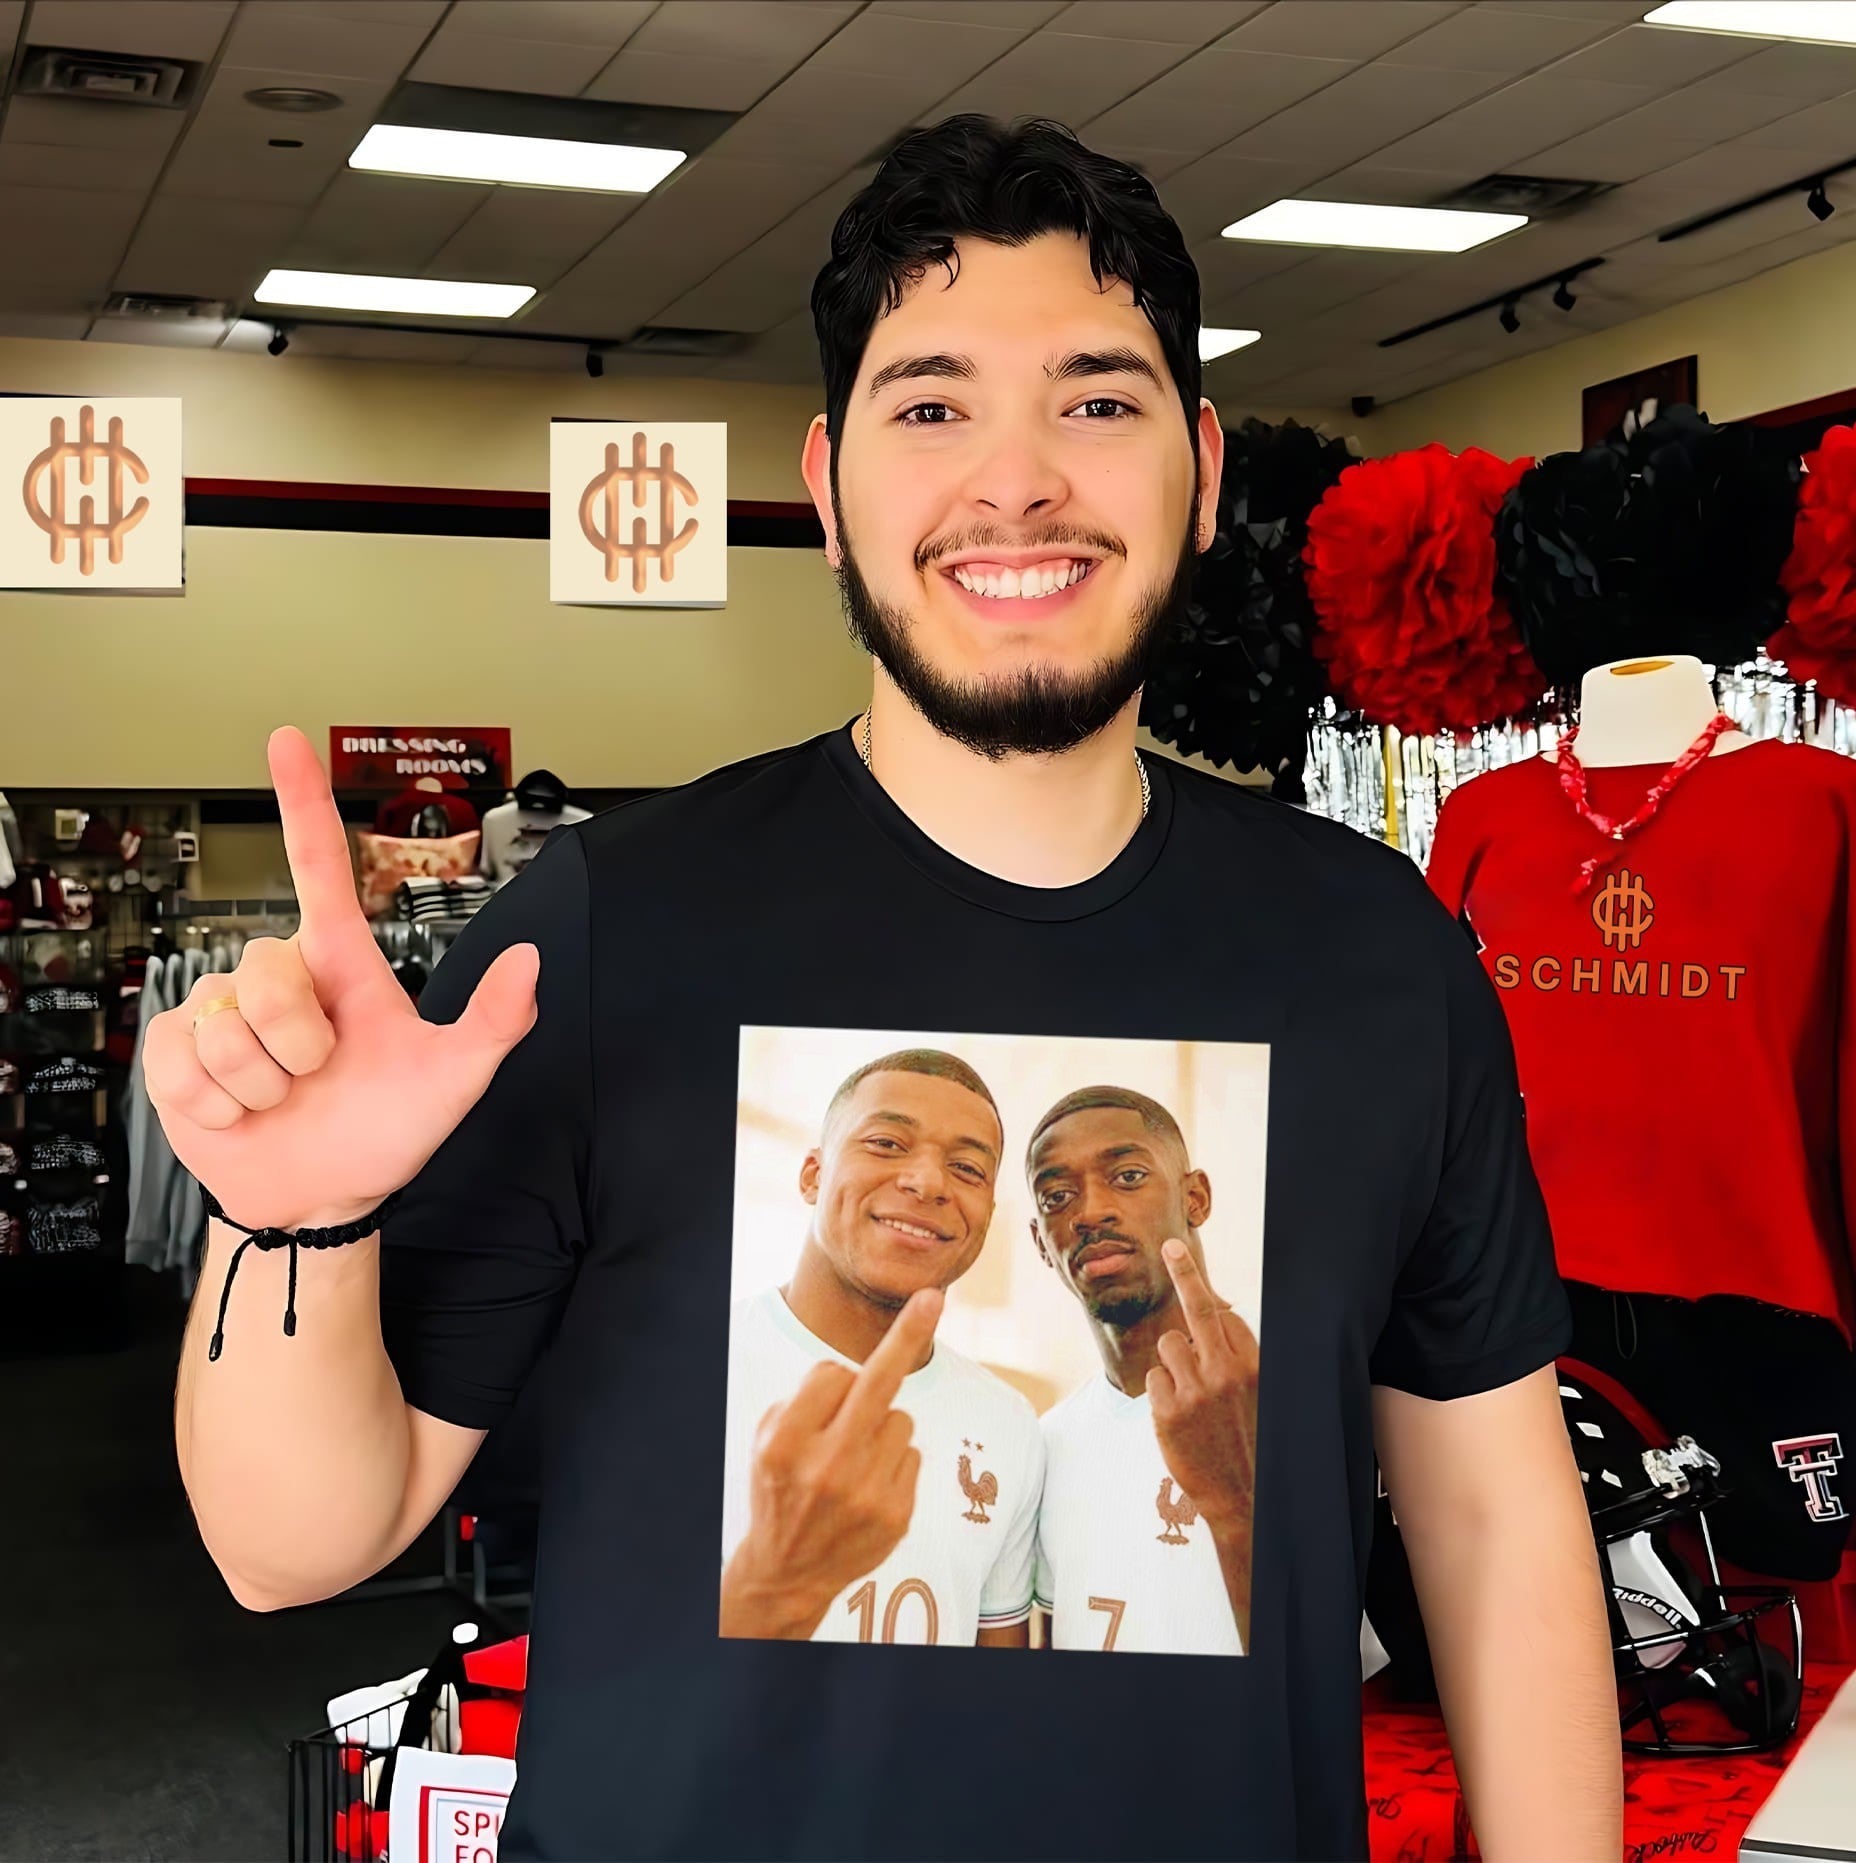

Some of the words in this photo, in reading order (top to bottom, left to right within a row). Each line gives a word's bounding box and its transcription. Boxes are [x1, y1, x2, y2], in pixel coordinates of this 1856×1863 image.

[342, 737, 467, 753] DRESSING
[396, 758, 487, 775] ROOMS
[1494, 953, 1747, 1000] SCHMIDT
[847, 1577, 939, 1645] 10
[1088, 1595, 1127, 1652] 7
